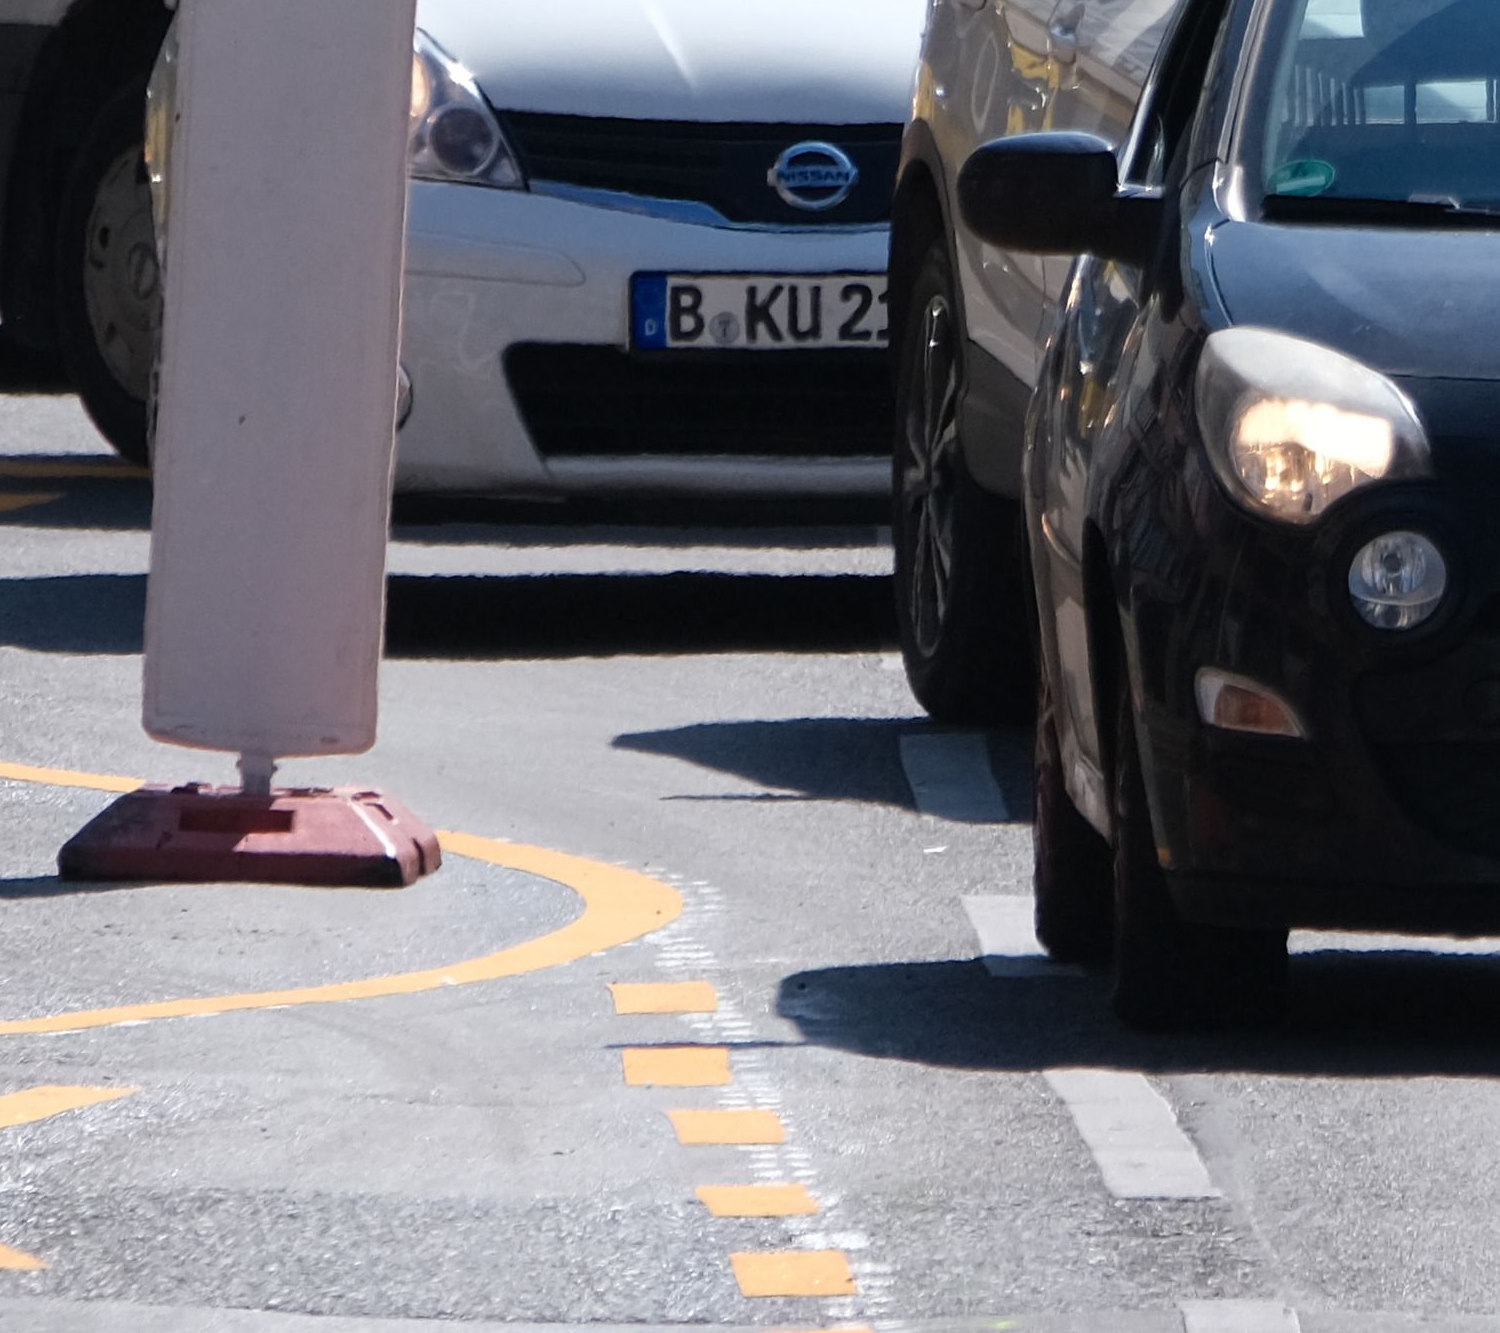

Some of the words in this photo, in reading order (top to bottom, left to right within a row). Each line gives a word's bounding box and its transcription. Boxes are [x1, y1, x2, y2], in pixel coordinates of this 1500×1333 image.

[776, 169, 850, 184] NISSAN
[669, 285, 706, 343] B
[745, 285, 823, 343] KU
